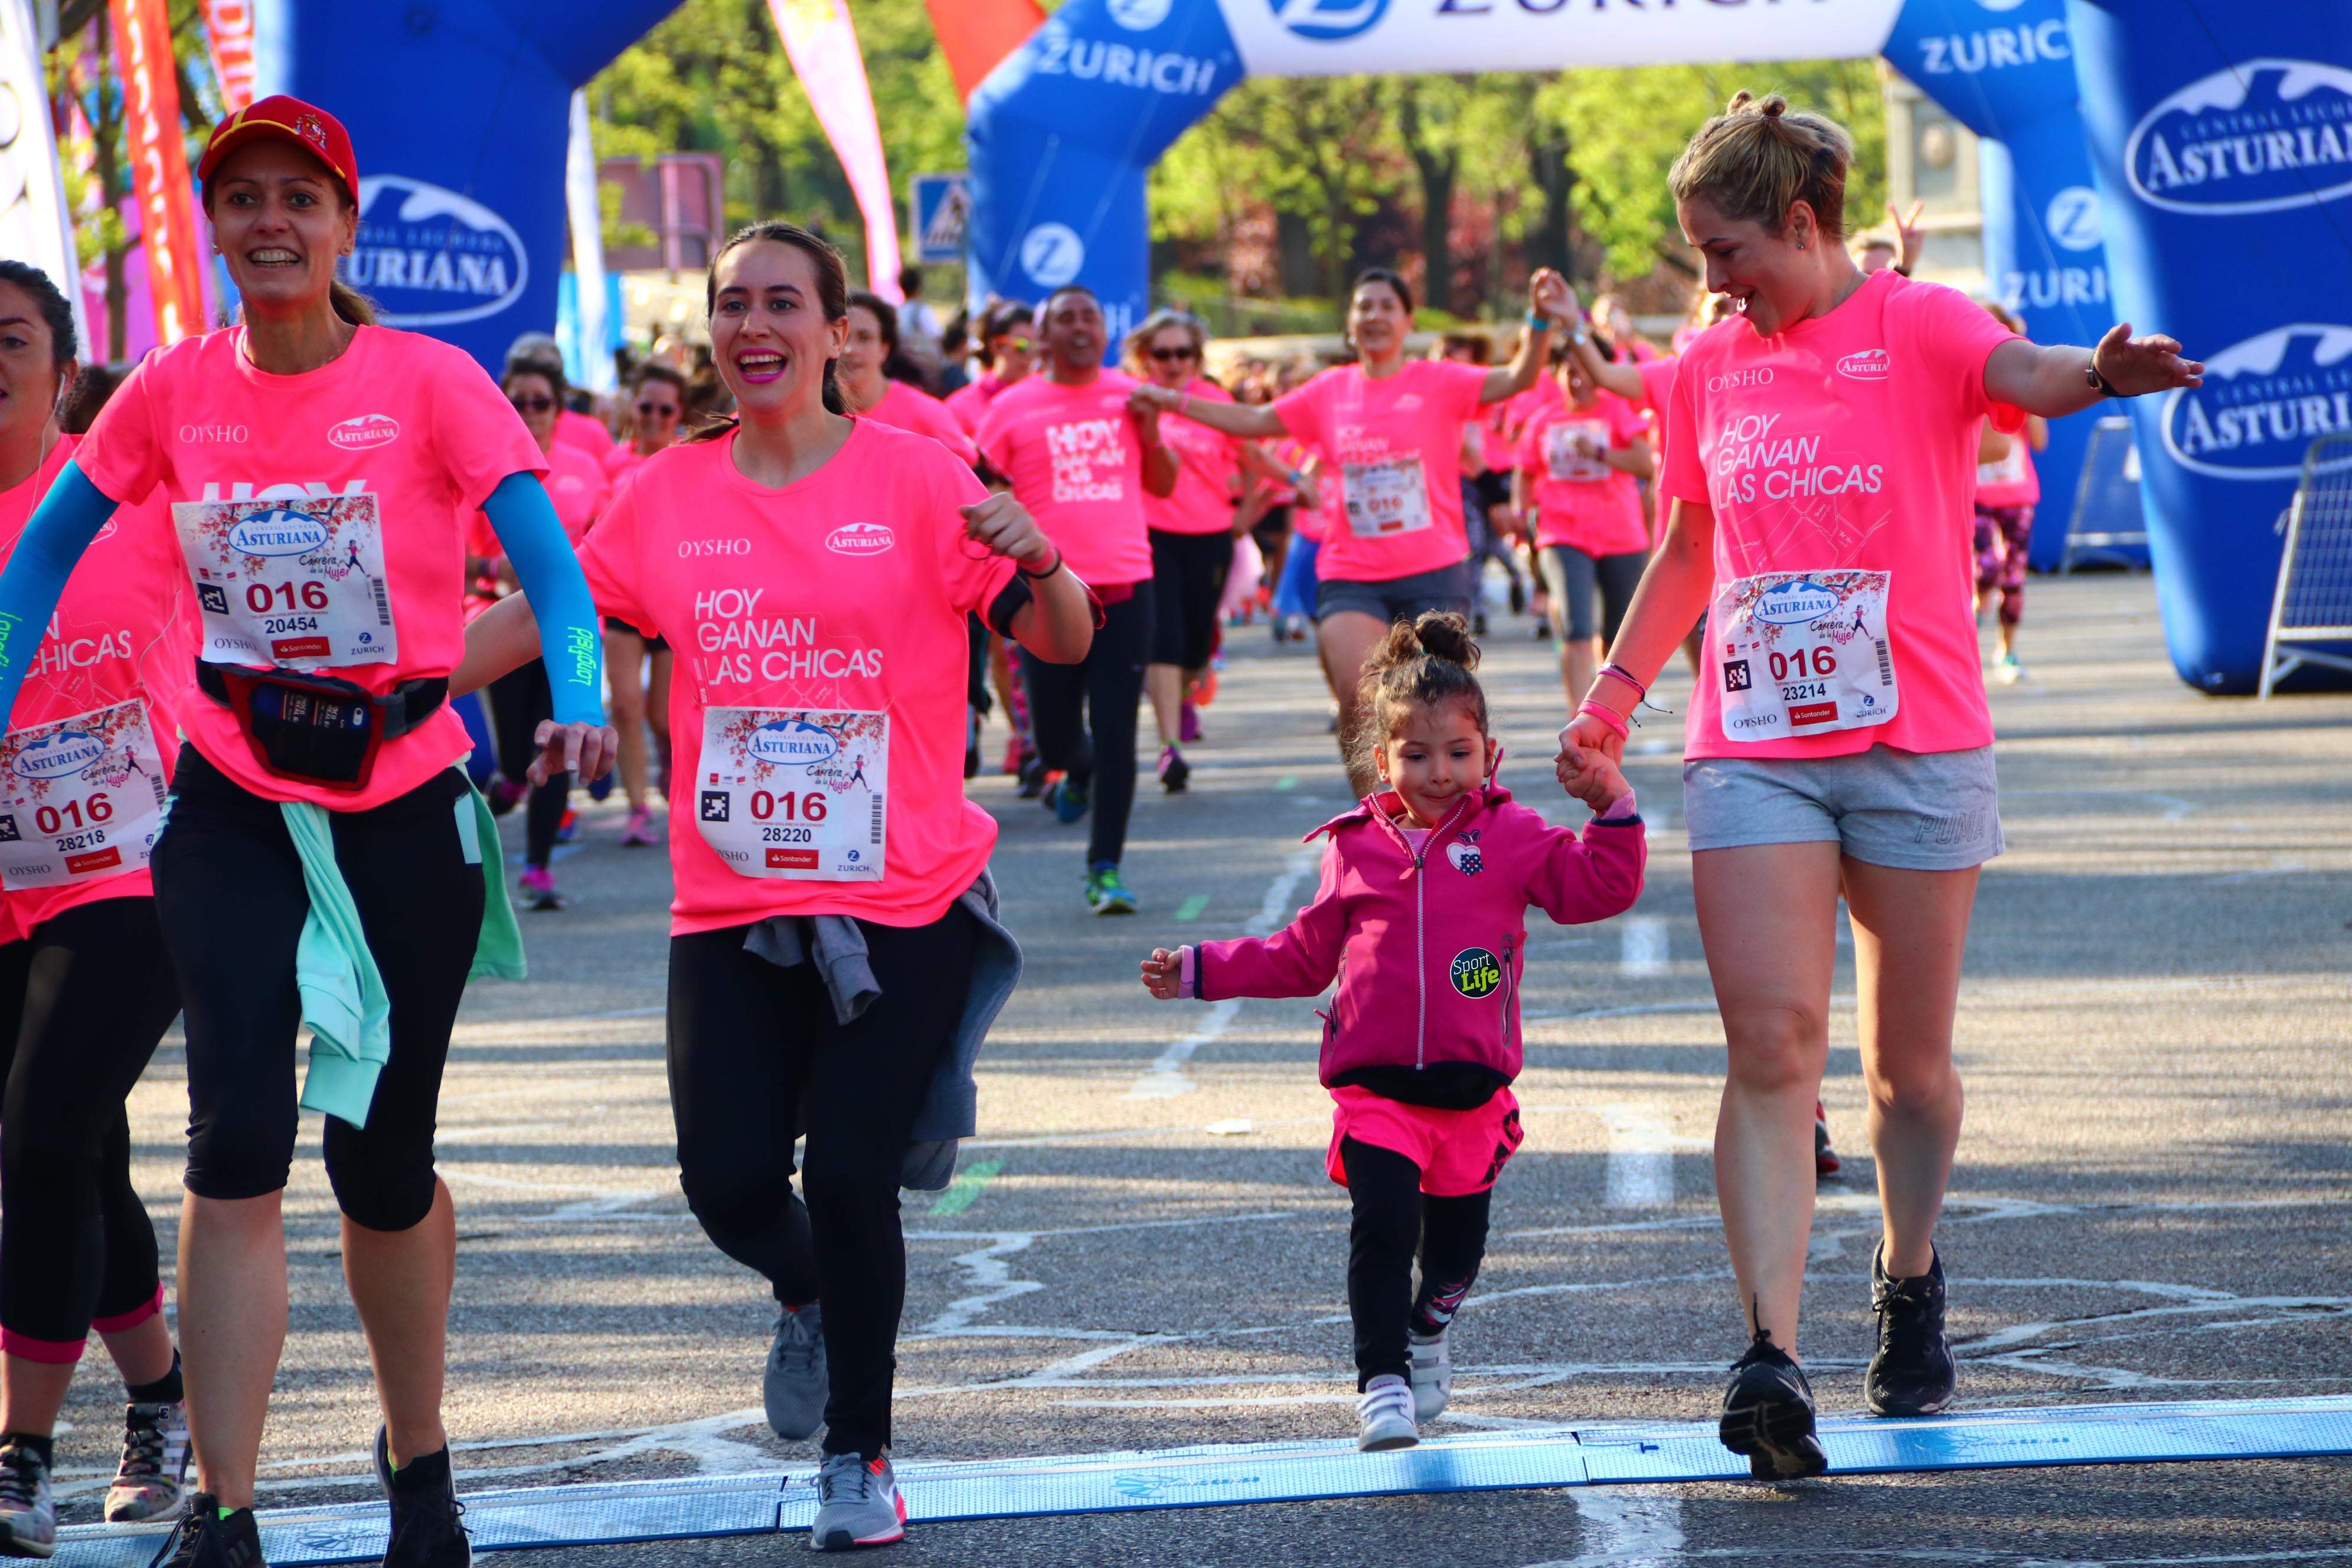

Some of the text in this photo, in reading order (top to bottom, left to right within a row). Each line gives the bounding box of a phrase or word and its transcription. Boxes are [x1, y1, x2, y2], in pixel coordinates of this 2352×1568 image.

[1039, 34, 1217, 95] ZURICH
[1709, 367, 1773, 392] OYSHO
[180, 425, 248, 443] OYSHO
[334, 428, 394, 442] ASTURIANA
[1719, 414, 1781, 447] HOY
[1717, 436, 1820, 476] GANAN
[1718, 465, 1883, 509] LAS CHICAS
[236, 529, 321, 547] ASTURIANA
[831, 535, 892, 548] ASTURIANA
[679, 538, 751, 558] OYSHO
[299, 555, 337, 566] Carrera
[324, 567, 349, 582] Mujer
[246, 580, 328, 613] 016
[695, 588, 764, 620] HOY
[1759, 599, 1832, 616] ASTURIANA
[265, 617, 318, 634] 20454
[698, 617, 815, 652] GANAN
[1811, 621, 1843, 631] Carrera
[214, 638, 257, 651] OYSHO
[1832, 631, 1855, 645] Mujer
[351, 646, 384, 655] ZURICH
[704, 654, 752, 685] LAS
[761, 648, 884, 681] CHICAS
[1769, 646, 1836, 680] 016
[1783, 683, 1826, 701] 23214
[1734, 713, 1777, 729] OYSHO
[1801, 710, 1830, 718] Santander
[1857, 708, 1886, 718] ZURICH
[753, 736, 830, 754] ASTURIANA
[21, 745, 99, 773] ASTURIANA
[81, 765, 116, 780] Carrera
[806, 765, 842, 776] Carrera
[106, 772, 129, 788] Mujer
[828, 778, 855, 793] Mujer
[35, 792, 112, 834] 016
[751, 790, 827, 821] 016
[762, 828, 811, 842] 28220
[1915, 811, 1986, 844] PUMA
[57, 829, 105, 851] 28218
[716, 850, 749, 861] YSHO
[9, 864, 51, 876] OYSHO
[1453, 953, 1490, 975] Sport
[1461, 966, 1500, 992] Life
